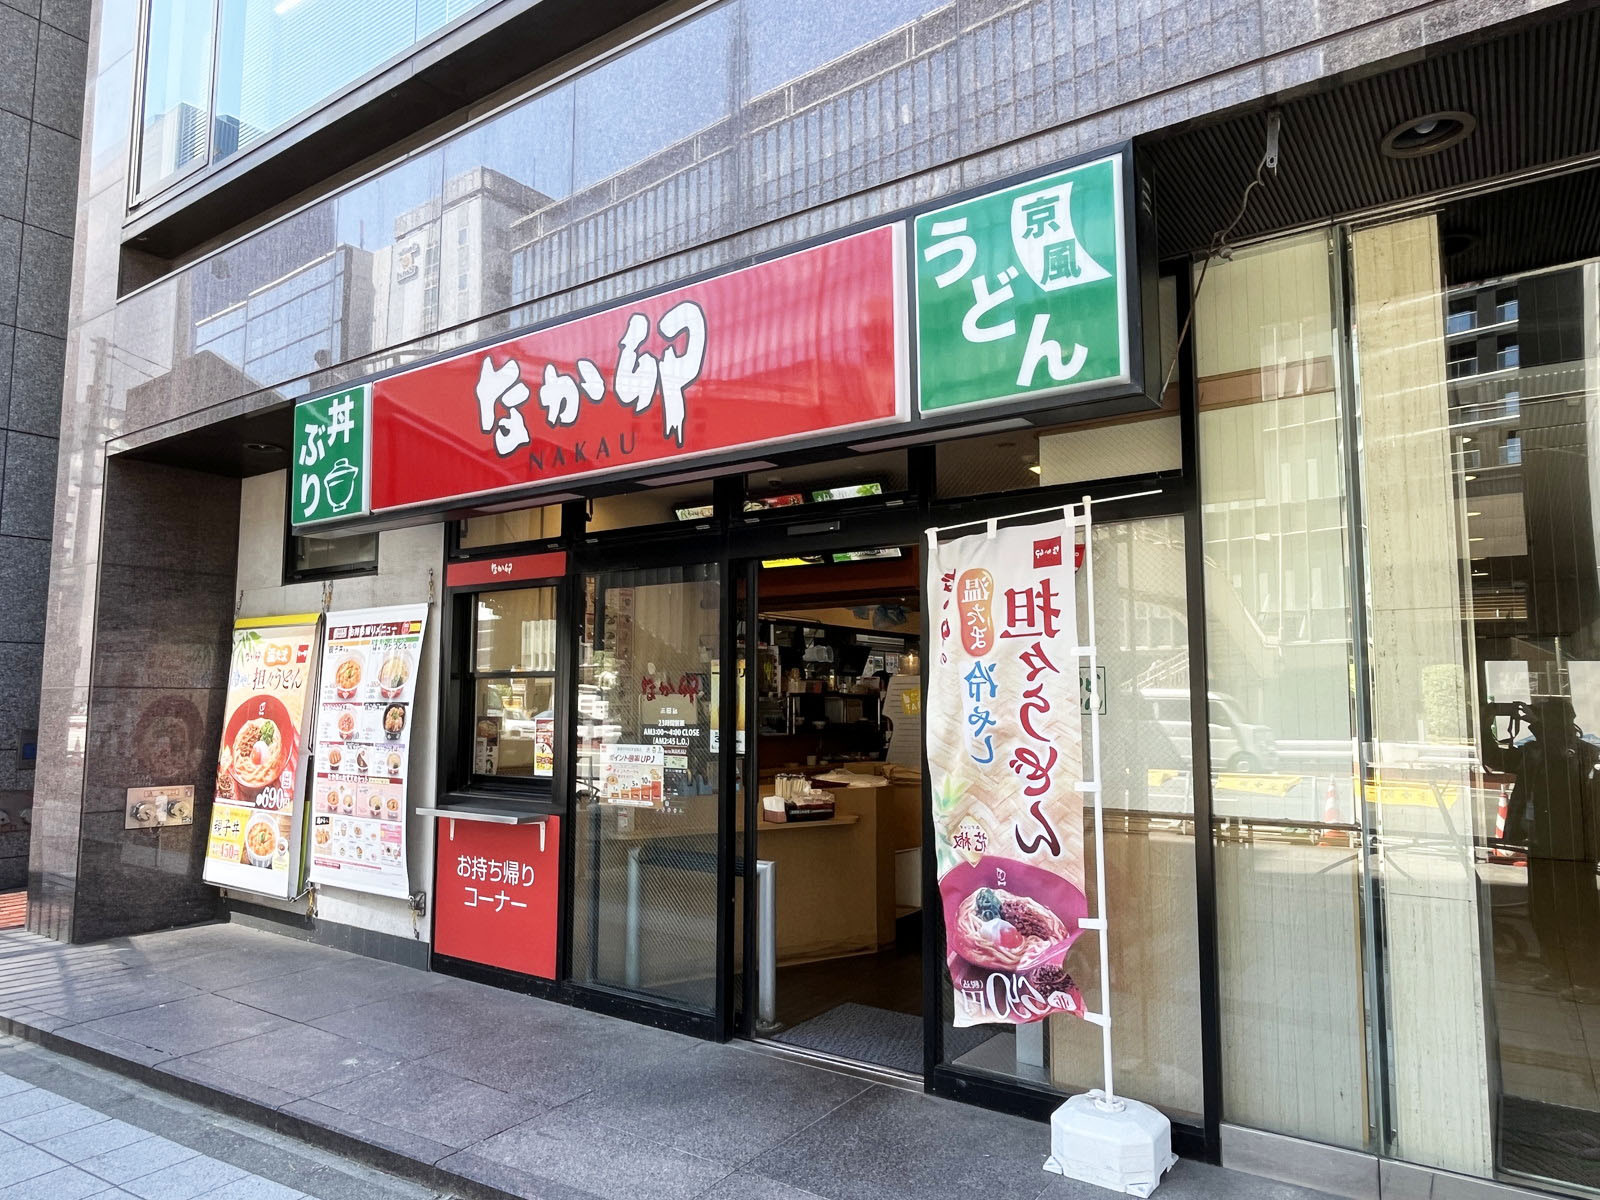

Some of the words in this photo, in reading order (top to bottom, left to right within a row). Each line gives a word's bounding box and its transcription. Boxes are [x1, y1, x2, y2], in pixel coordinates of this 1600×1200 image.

[1021, 196, 1081, 285] 京風
[923, 217, 1089, 387] うどん
[475, 300, 707, 458] なか卯
[528, 432, 637, 471] NAKAU
[491, 562, 513, 575] なか卯
[641, 673, 700, 704] なか卯
[682, 729, 700, 737] CLOSE
[456, 854, 535, 887] お持ち帰り
[463, 886, 528, 912] コーナー
